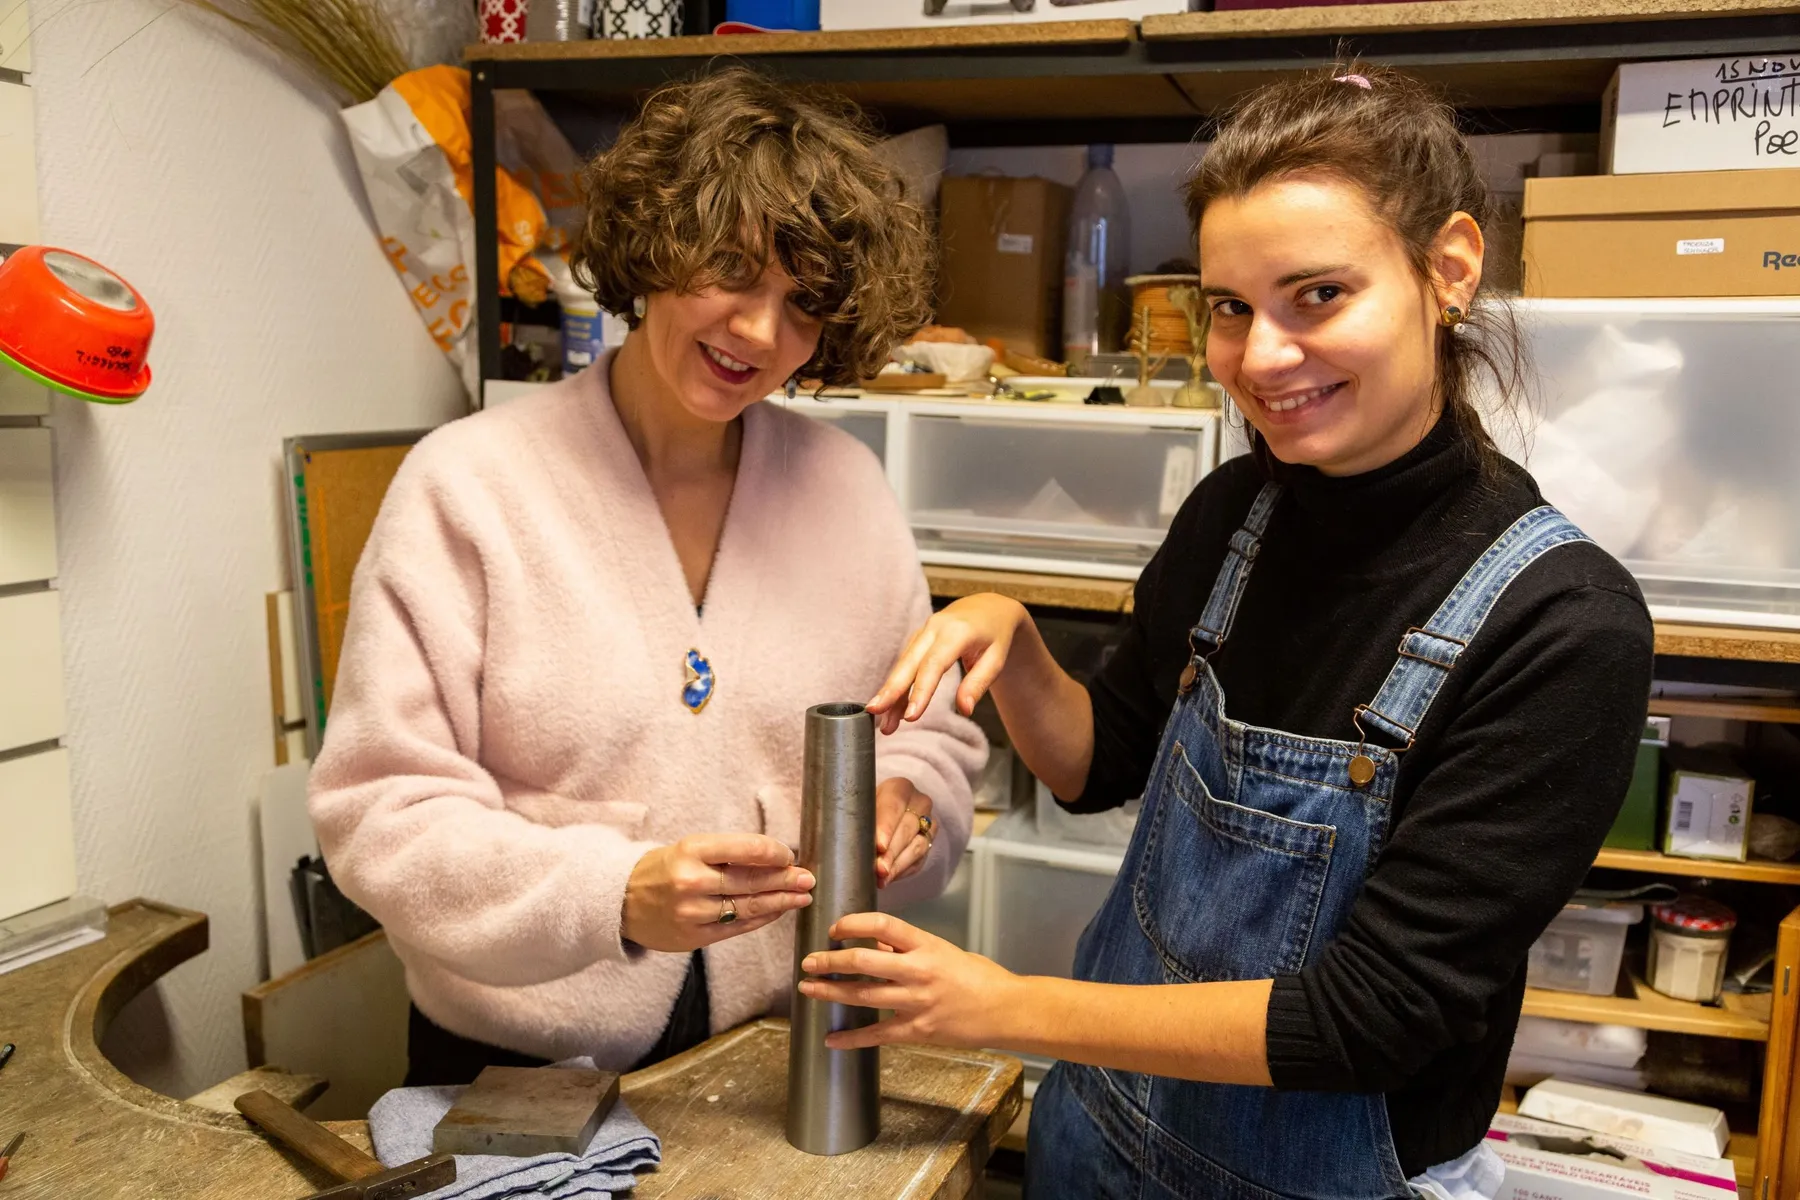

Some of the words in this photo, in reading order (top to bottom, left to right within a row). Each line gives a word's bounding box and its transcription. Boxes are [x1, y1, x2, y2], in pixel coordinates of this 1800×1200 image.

[1715, 59, 1740, 80] 15
[1663, 77, 1800, 127] EMPRINT
[1763, 251, 1800, 270] Re
